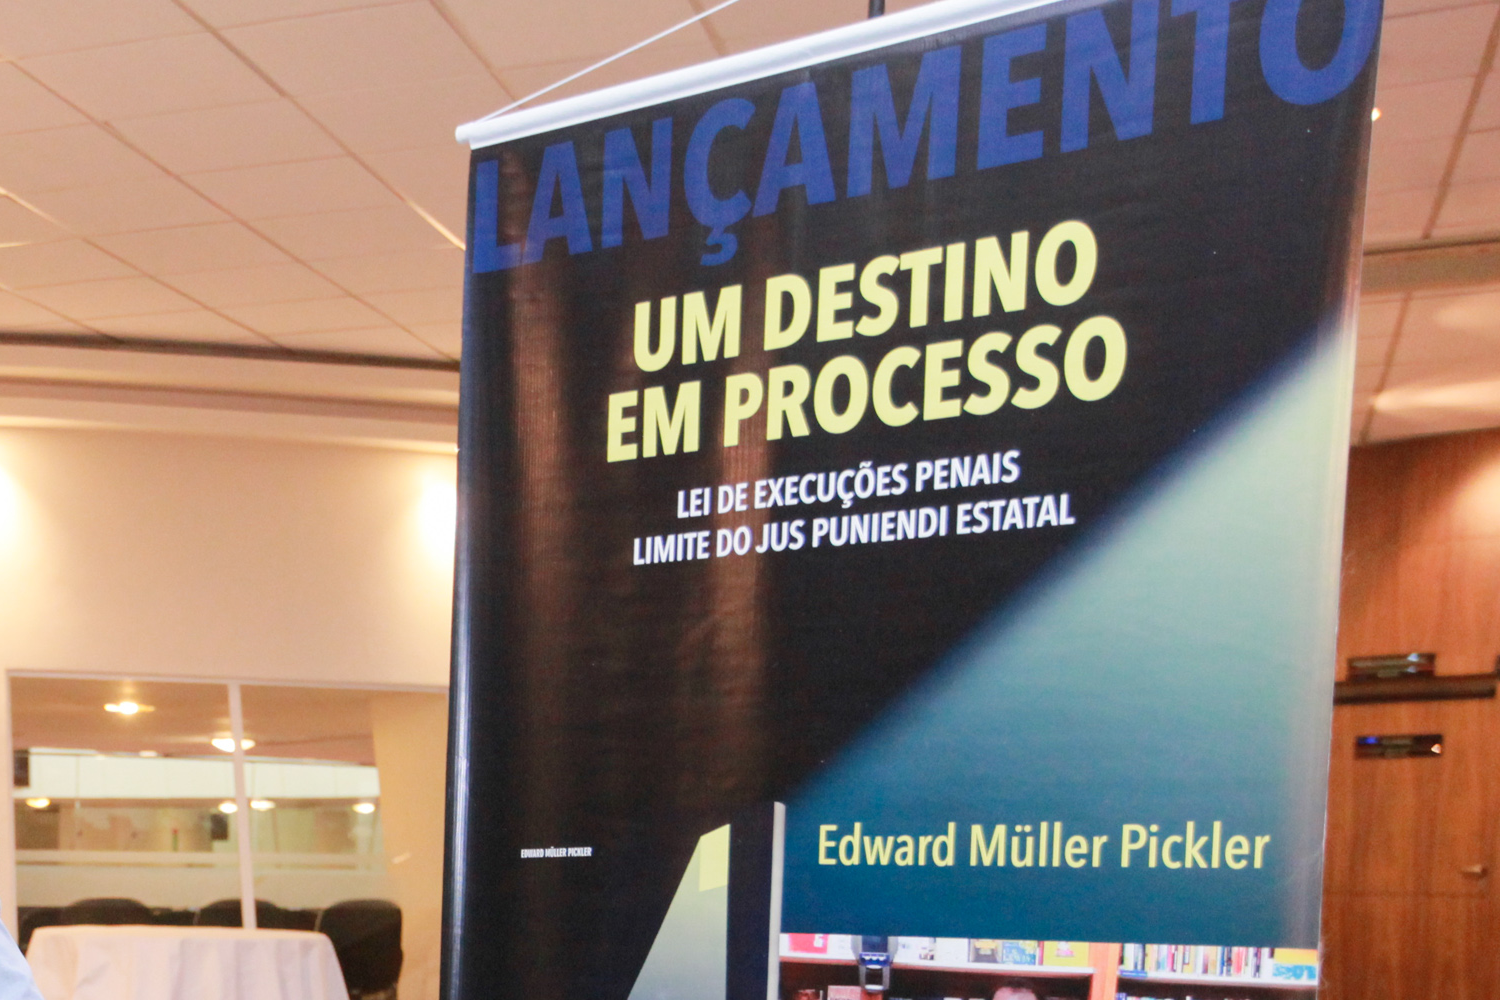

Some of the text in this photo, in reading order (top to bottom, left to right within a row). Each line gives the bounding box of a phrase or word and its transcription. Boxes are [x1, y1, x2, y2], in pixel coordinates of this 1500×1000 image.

[472, 0, 1382, 273] LANÇAMENTO
[633, 220, 1098, 372] UM DESTINO
[607, 315, 1128, 463] EM PROCESSO
[633, 493, 1076, 565] LIMITE DO JUS PUNIENDI ESTATAL
[677, 449, 1021, 518] LEI DE EXECUÇÕES PENAIS
[818, 820, 1271, 869] Edward Müller Pickler
